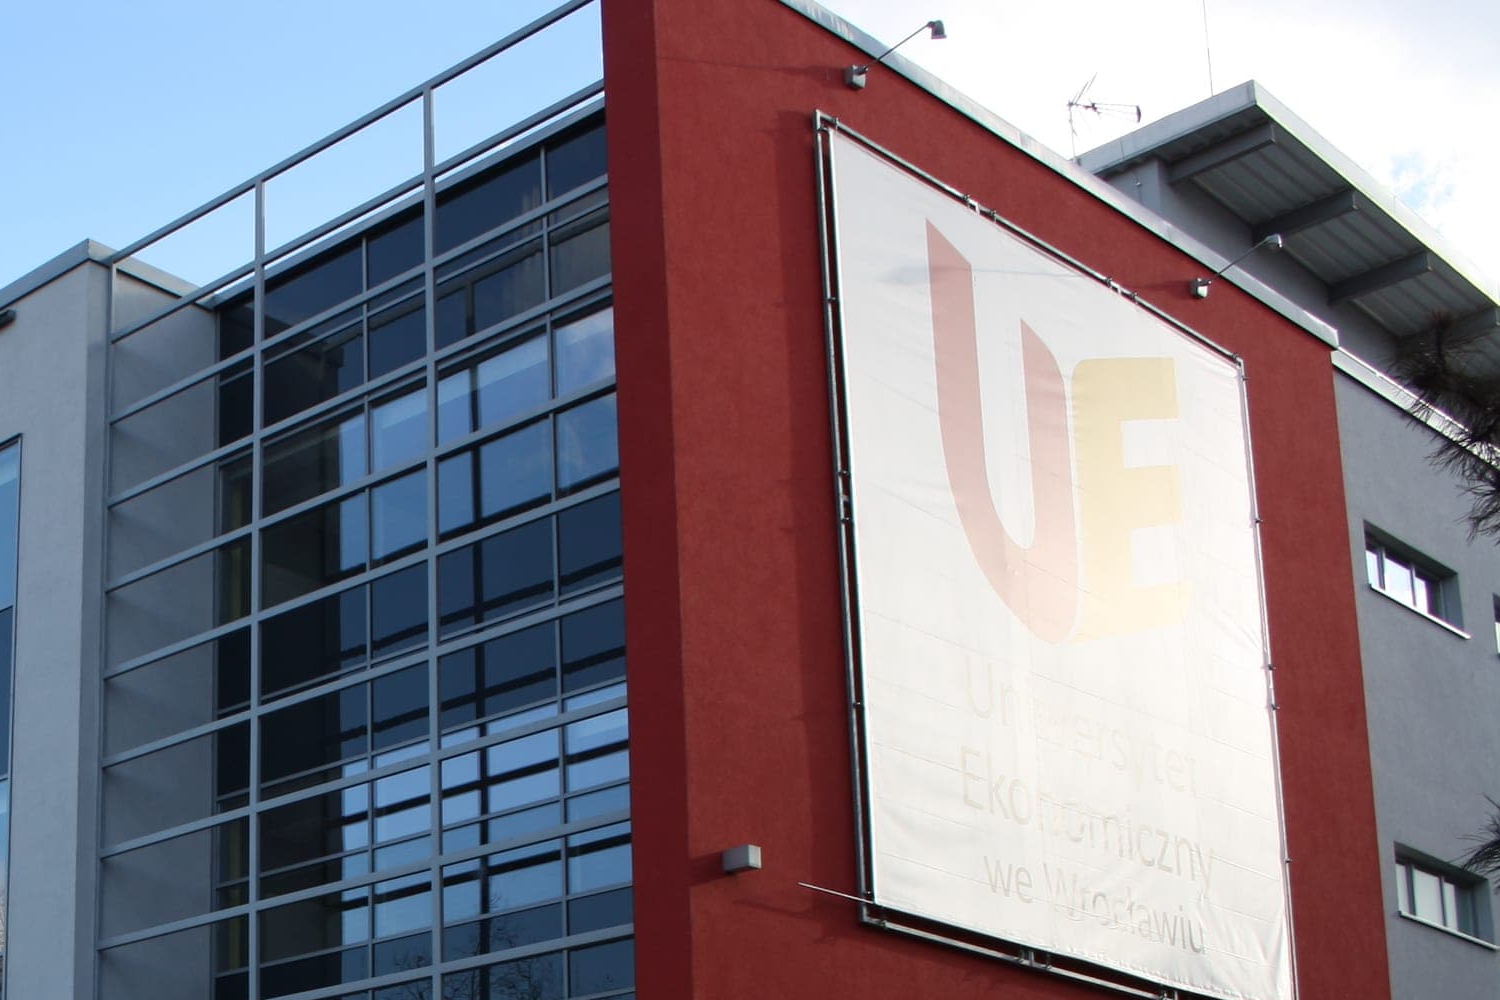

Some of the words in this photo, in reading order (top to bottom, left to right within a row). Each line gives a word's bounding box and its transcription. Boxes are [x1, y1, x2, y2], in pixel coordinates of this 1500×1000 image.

[925, 217, 1193, 646] UE
[965, 655, 1198, 799] Unwersytet
[983, 854, 1034, 905] we
